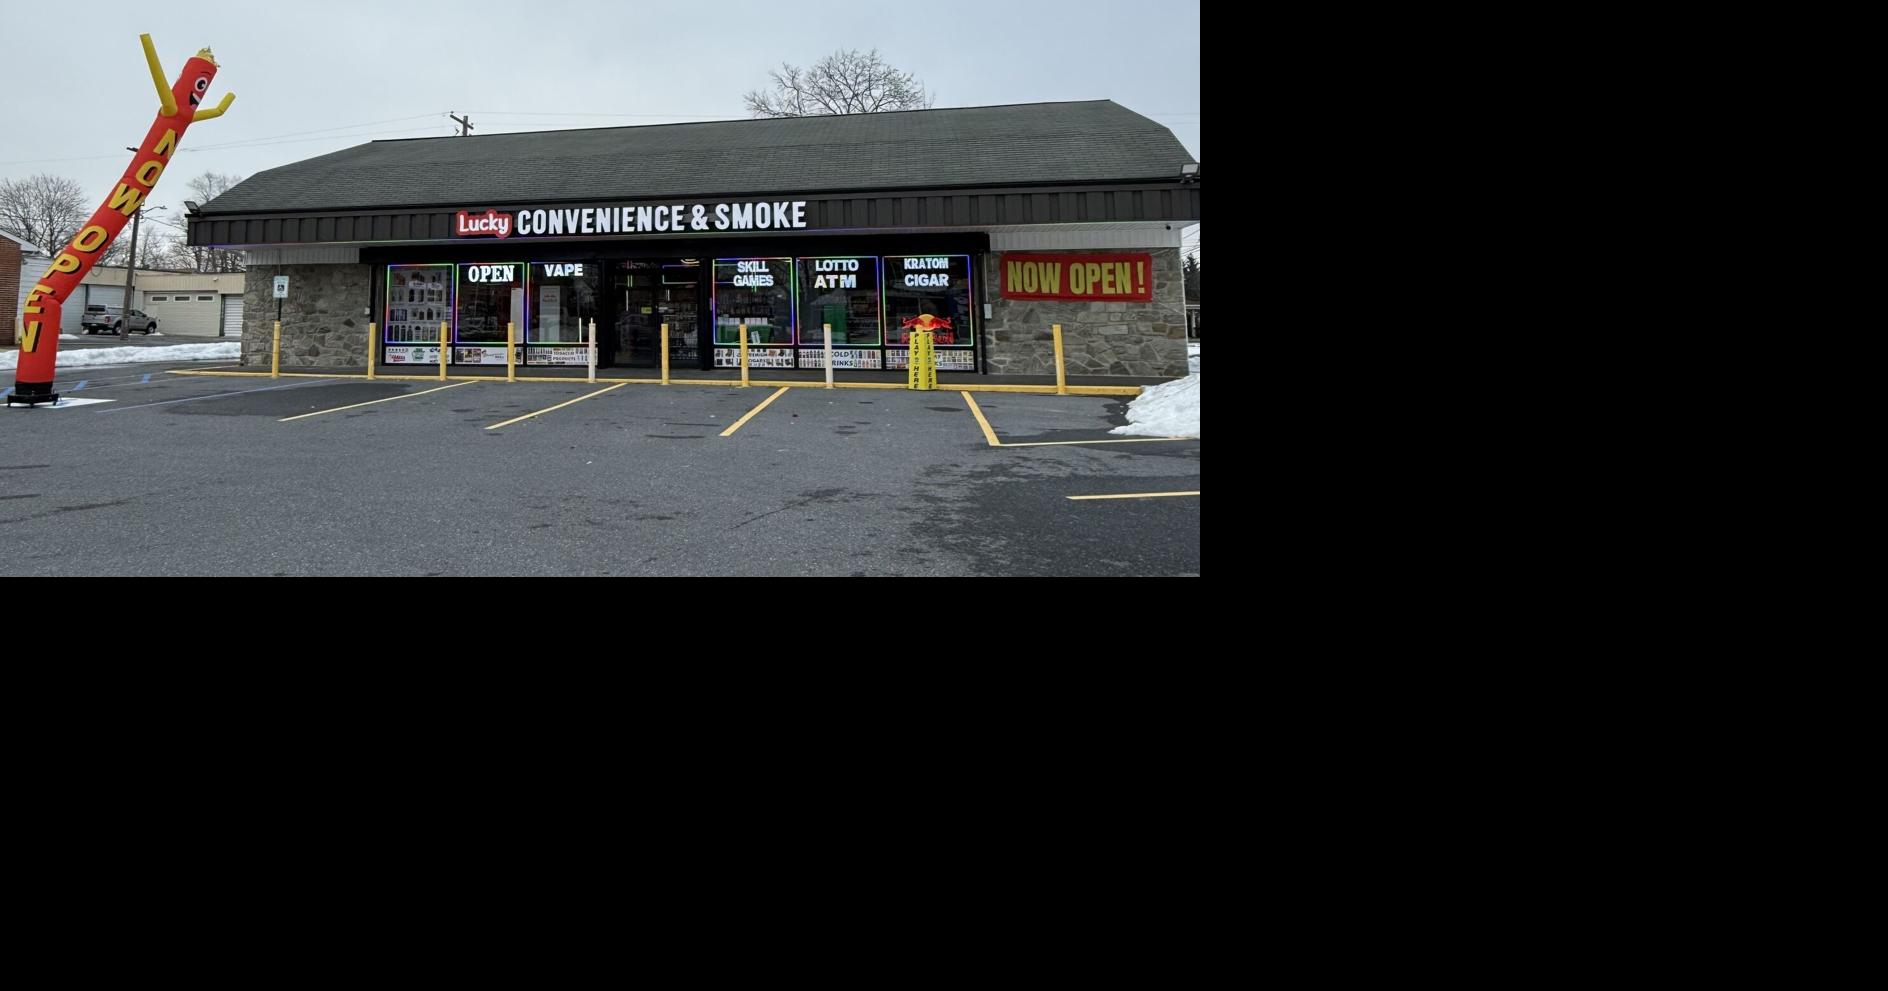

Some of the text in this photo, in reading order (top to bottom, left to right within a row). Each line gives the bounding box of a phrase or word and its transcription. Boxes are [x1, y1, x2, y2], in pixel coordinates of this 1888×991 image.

[108, 128, 178, 217] NOW
[459, 201, 807, 235] Lucky CONVENIENCE & SMOKE
[544, 263, 583, 277] VAPE
[737, 261, 769, 273] SKILL
[815, 260, 859, 272] LOTTO
[904, 258, 949, 270] KRATOM
[468, 265, 515, 282] OPEN
[733, 274, 774, 287] GAMES
[904, 273, 949, 287] CIGAR
[1007, 260, 1061, 294] NOW
[814, 274, 857, 288] ATM
[21, 225, 108, 352] OPEN
